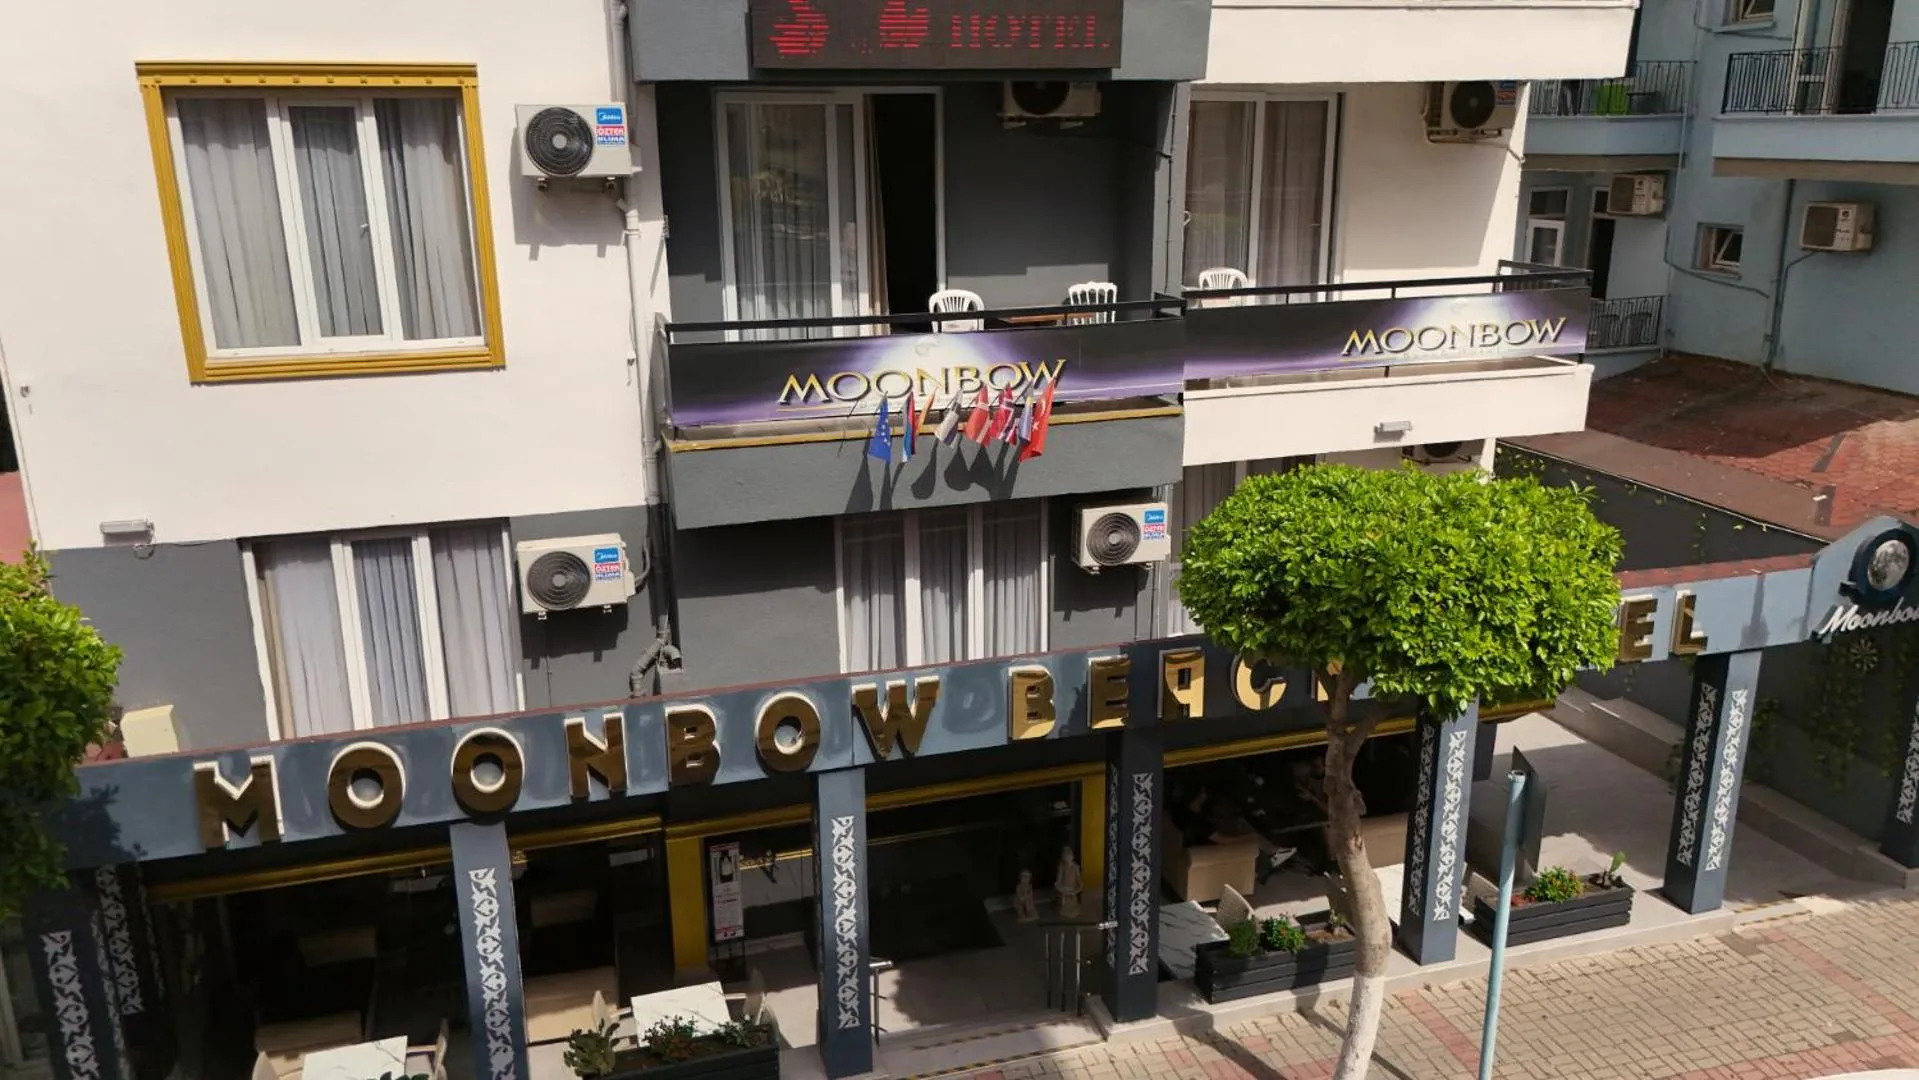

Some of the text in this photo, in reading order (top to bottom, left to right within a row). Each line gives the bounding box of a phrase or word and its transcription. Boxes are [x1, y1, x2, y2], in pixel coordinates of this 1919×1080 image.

[1340, 316, 1567, 356] MOONBOW
[776, 358, 1067, 405] MOONBOW
[193, 675, 941, 849] MOONBOW
